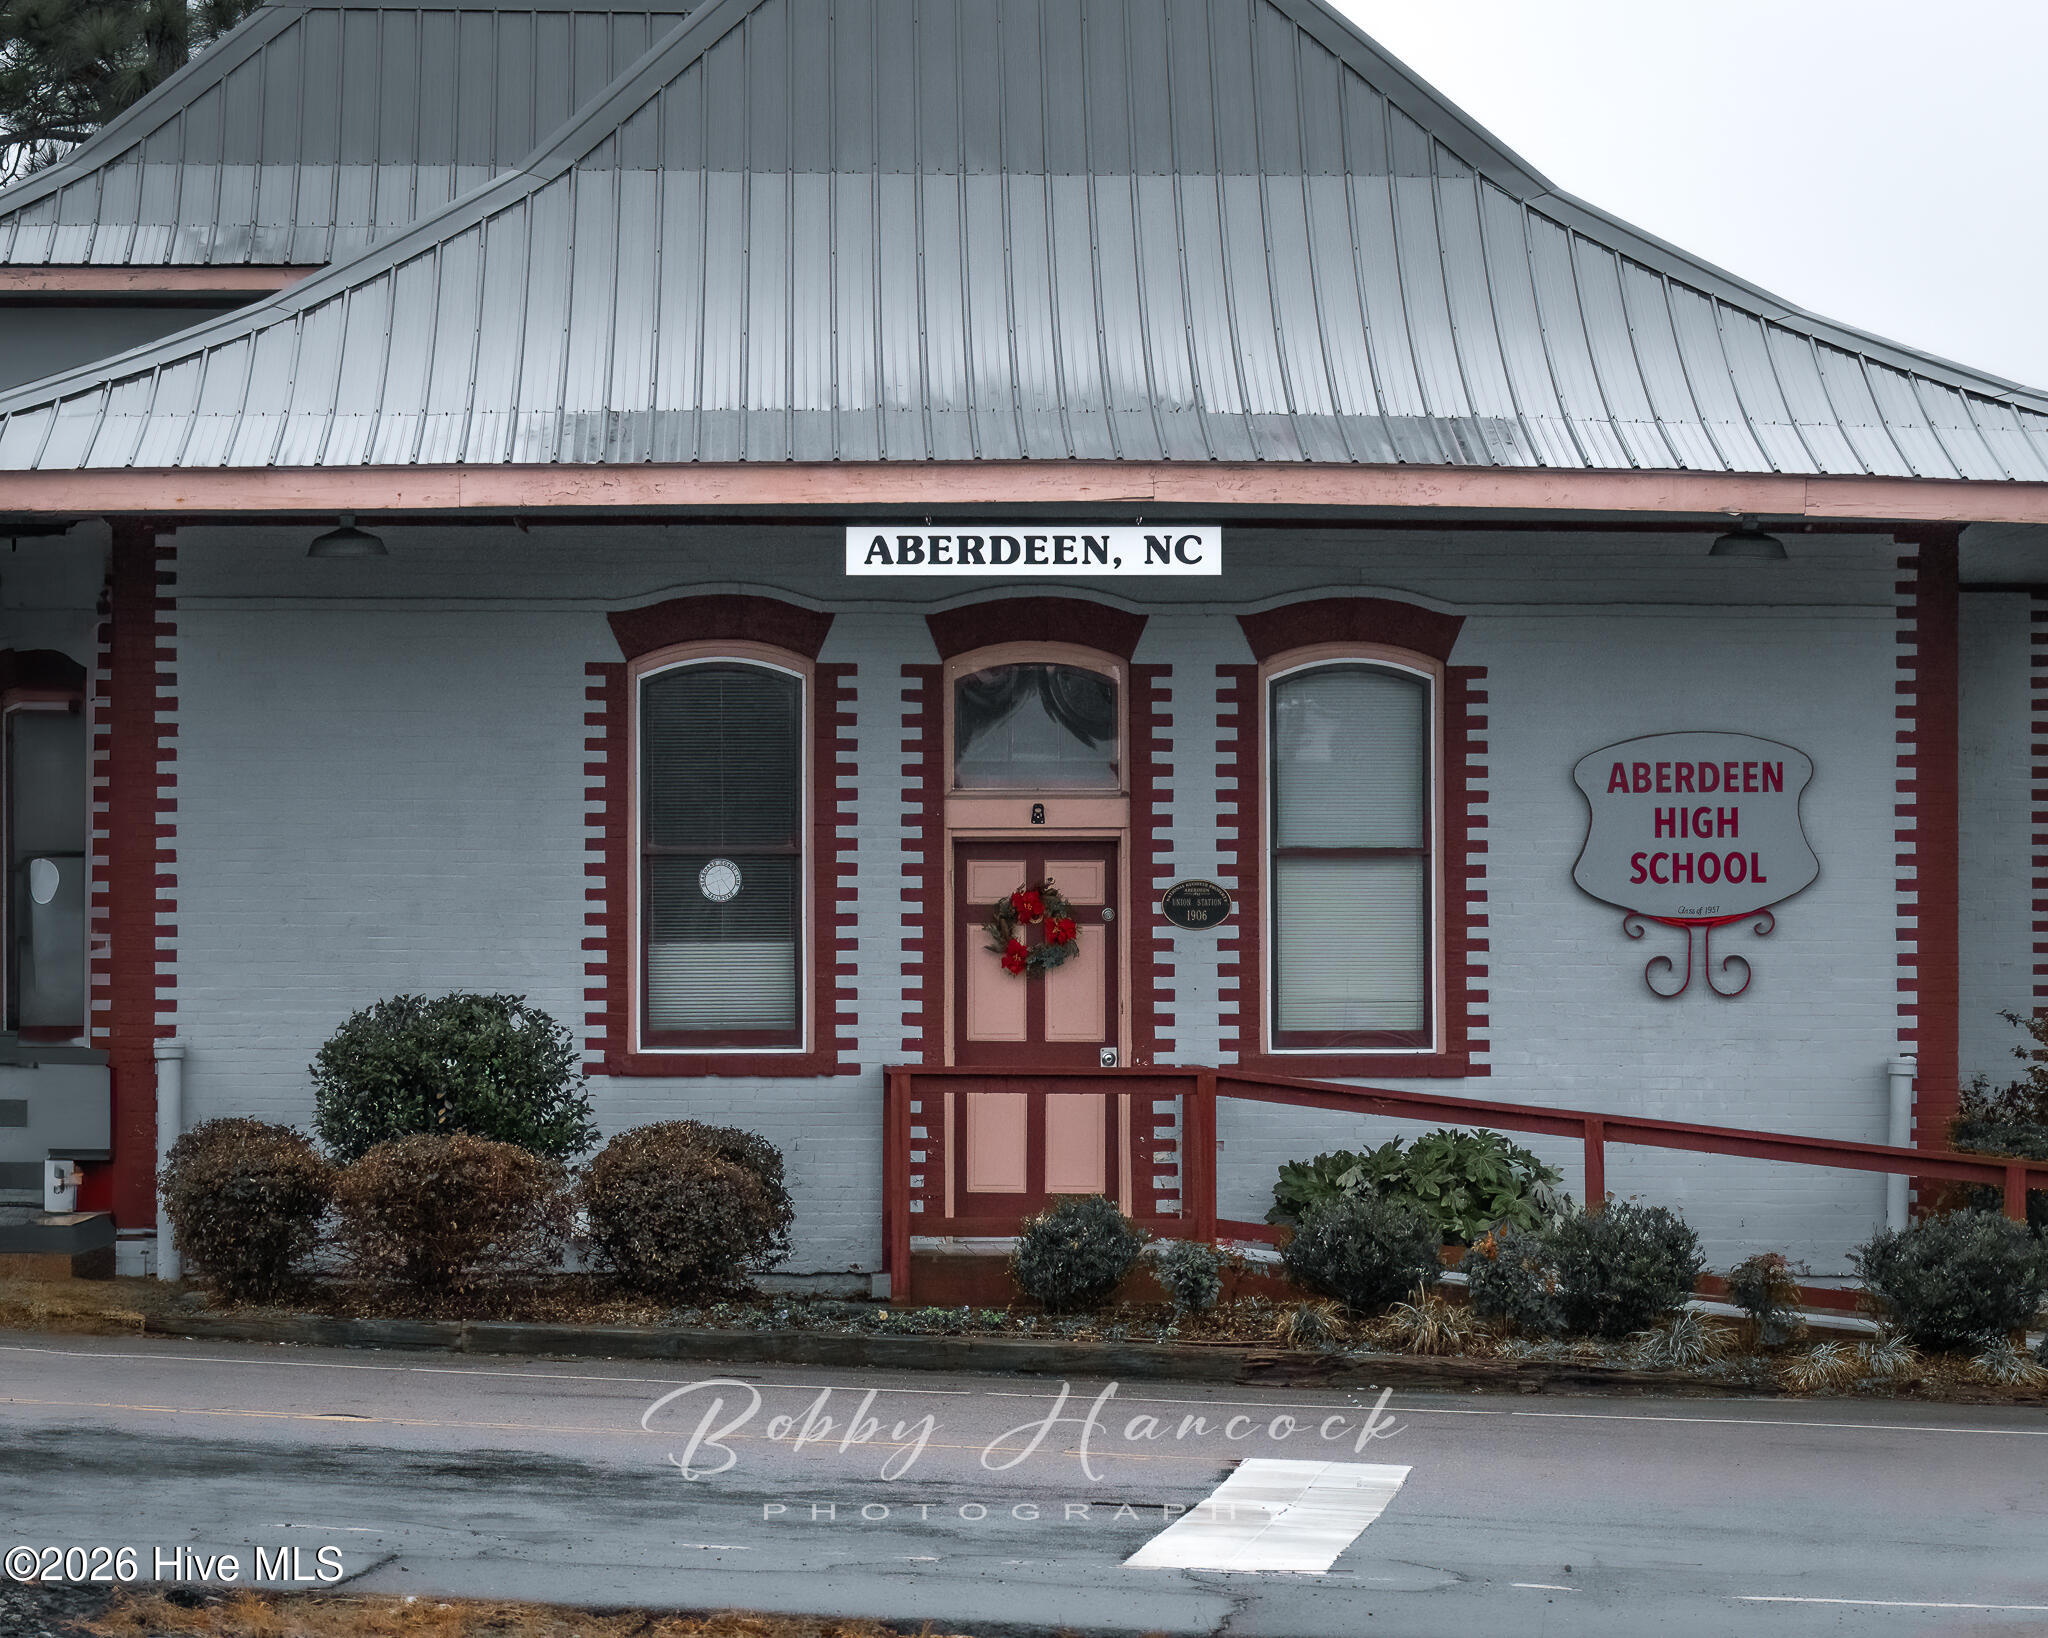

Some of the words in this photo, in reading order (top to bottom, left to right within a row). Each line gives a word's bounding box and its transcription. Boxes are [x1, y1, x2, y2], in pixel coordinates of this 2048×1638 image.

[864, 535, 1122, 570] ABERDEEN,
[1144, 535, 1203, 565] NC
[1607, 761, 1783, 794] ABERDEEN
[1654, 806, 1739, 839] HIGH
[1630, 851, 1768, 884] SCHOOL
[1172, 898, 1191, 906] UNION
[1197, 898, 1222, 906] STATION
[1187, 910, 1208, 920] 1906
[1677, 905, 1696, 914] Class
